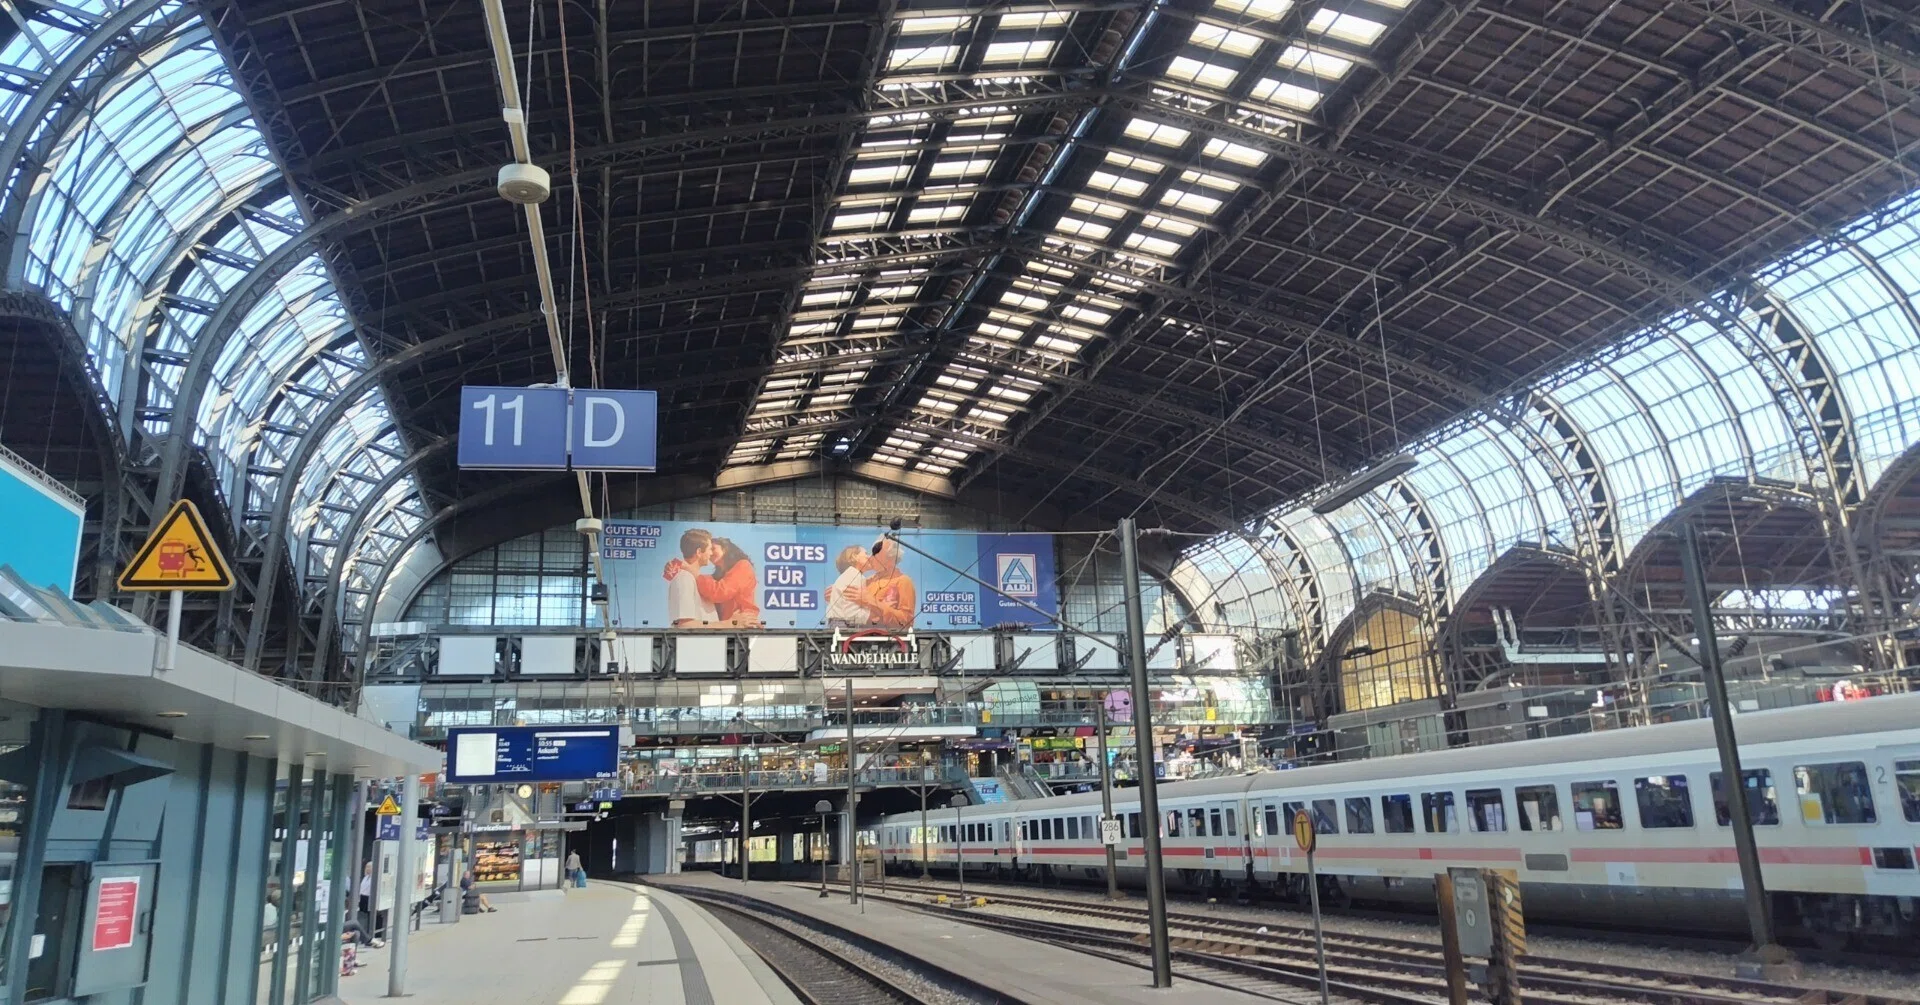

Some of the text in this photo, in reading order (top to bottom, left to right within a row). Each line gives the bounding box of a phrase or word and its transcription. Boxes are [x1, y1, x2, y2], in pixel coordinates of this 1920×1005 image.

[473, 394, 625, 447] 11 D
[605, 525, 661, 536] GUTES FÜR
[605, 538, 656, 548] DIE ERSTE
[604, 550, 635, 559] LIEBE.
[767, 545, 825, 561] GUTES
[767, 566, 804, 585] FÜR
[766, 592, 815, 608] ALLE.
[927, 592, 974, 601] GUTES FÜR
[923, 604, 975, 613] DIE GROSSE
[830, 652, 919, 665] WANDELHALLE
[1875, 766, 1888, 784] 2
[595, 789, 617, 798] 11 E
[1103, 822, 1119, 831] 286
[1109, 832, 1115, 841] 6
